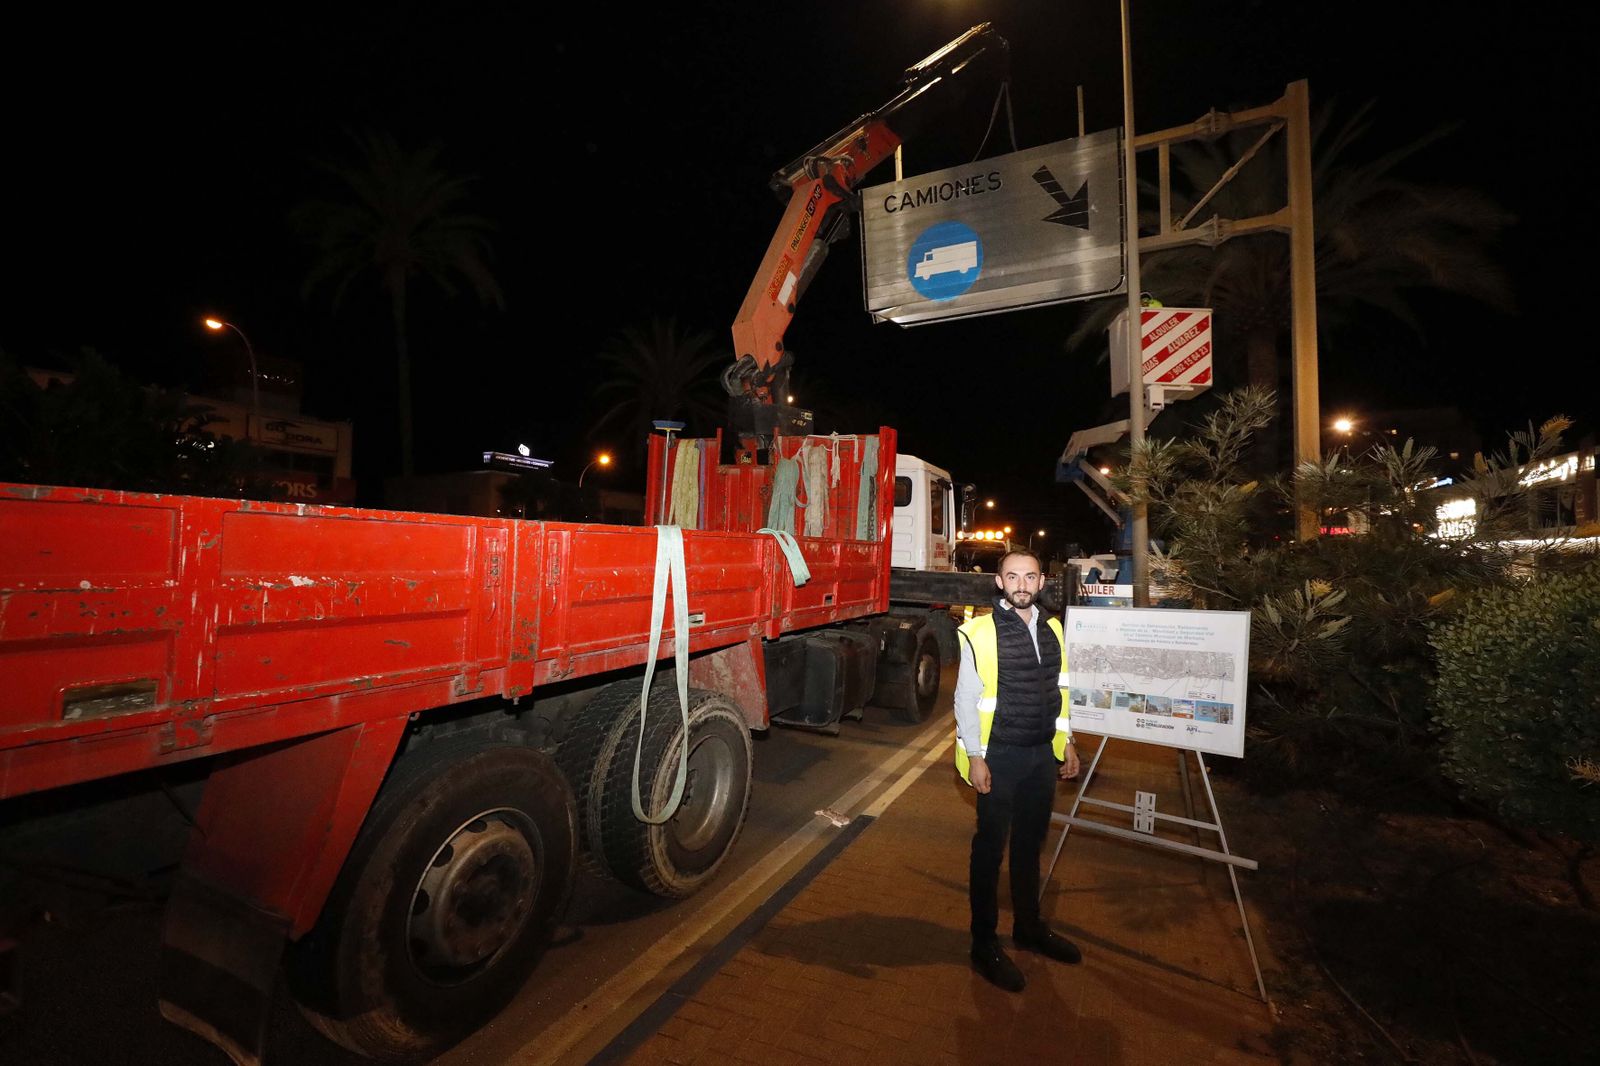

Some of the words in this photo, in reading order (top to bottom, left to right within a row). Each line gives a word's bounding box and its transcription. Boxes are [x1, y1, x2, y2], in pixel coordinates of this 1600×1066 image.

[884, 171, 1003, 213] CAMIONES
[790, 212, 812, 251] PALFINGER
[1148, 317, 1180, 342] ALQUILER
[1167, 326, 1200, 354] ALVAREZ
